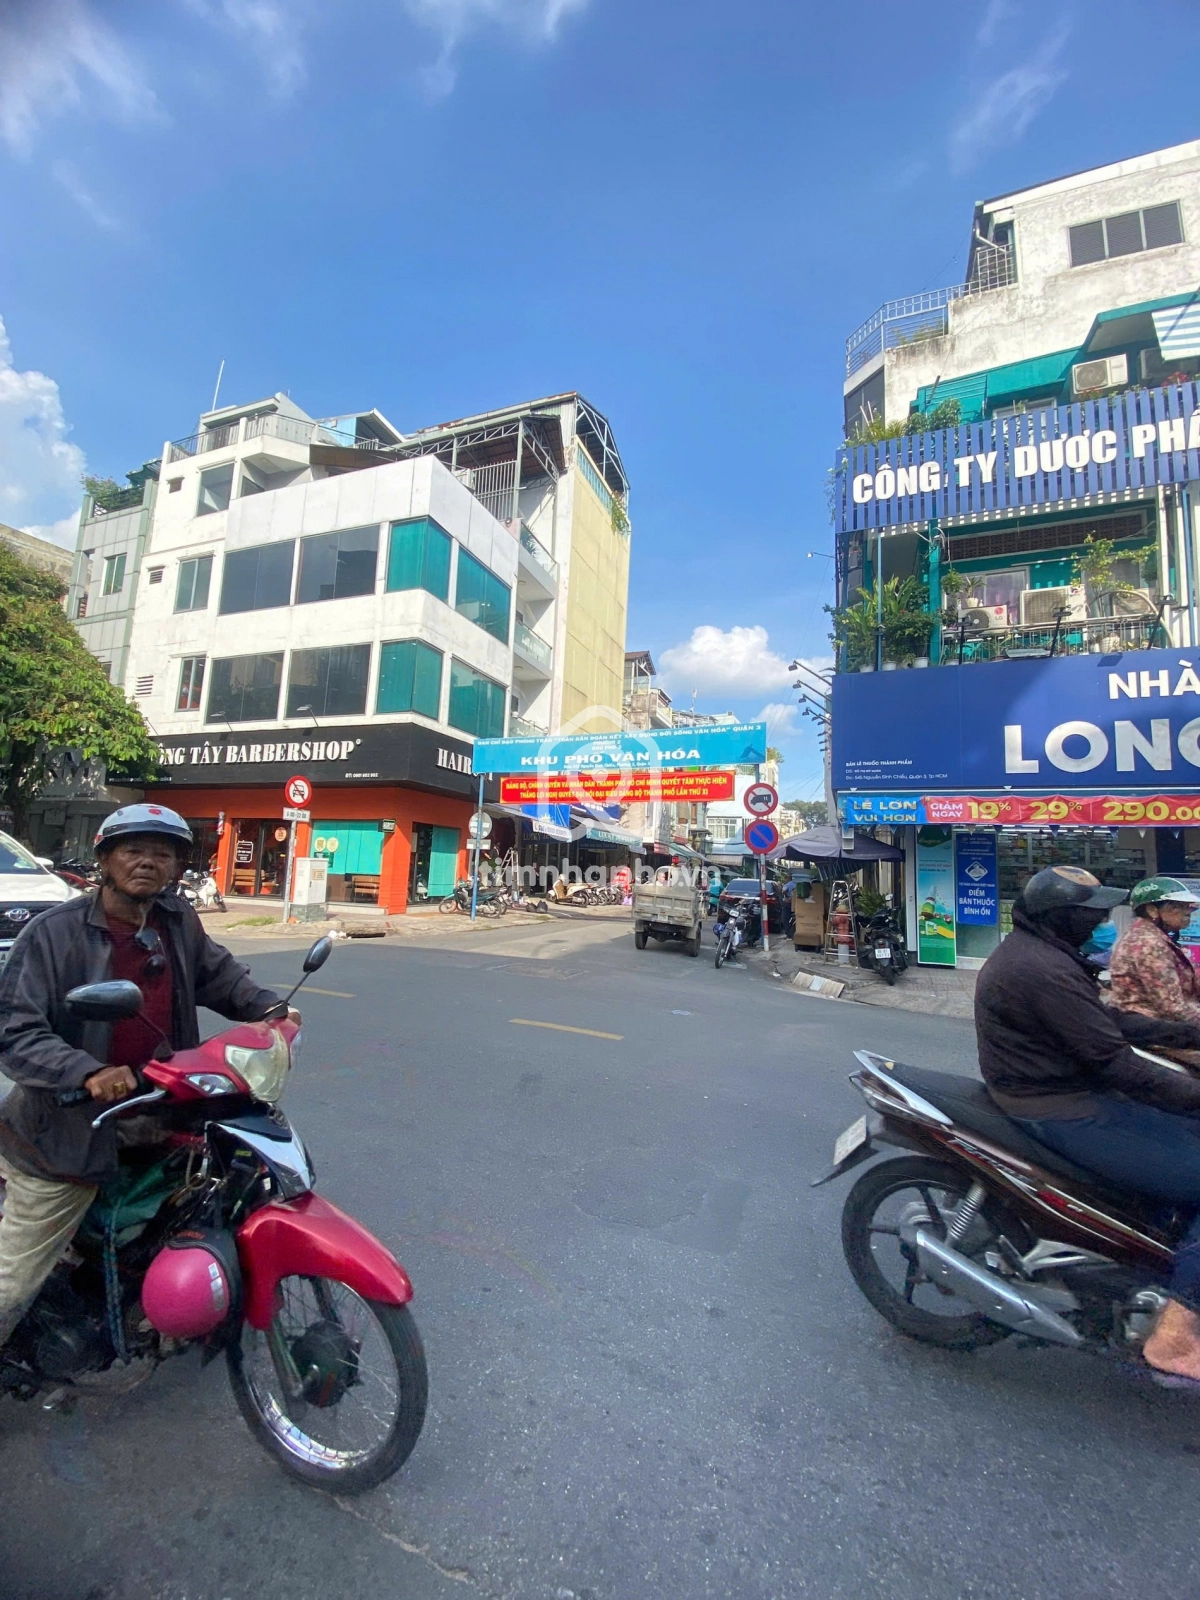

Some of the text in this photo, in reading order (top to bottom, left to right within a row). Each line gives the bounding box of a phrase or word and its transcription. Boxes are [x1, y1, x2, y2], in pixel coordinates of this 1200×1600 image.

[852, 461, 940, 504] CÔNG
[953, 451, 998, 488] TY
[1014, 429, 1118, 478] DƯỢC
[1108, 659, 1200, 700] NHÀ
[733, 725, 754, 733] QUẬN
[189, 740, 223, 765] TÂY
[225, 740, 356, 764] BARBERSHOP
[521, 747, 701, 766] KHU PHỐ VĂN HÓA
[930, 800, 963, 810] GIẢM
[854, 813, 878, 822] VUI
[931, 810, 963, 818] NGAY
[968, 887, 986, 897] ĐIỂM
[1134, 882, 1159, 896] Grab
[959, 896, 996, 906] BÁN THUỐC
[963, 906, 980, 915] BÌNH
